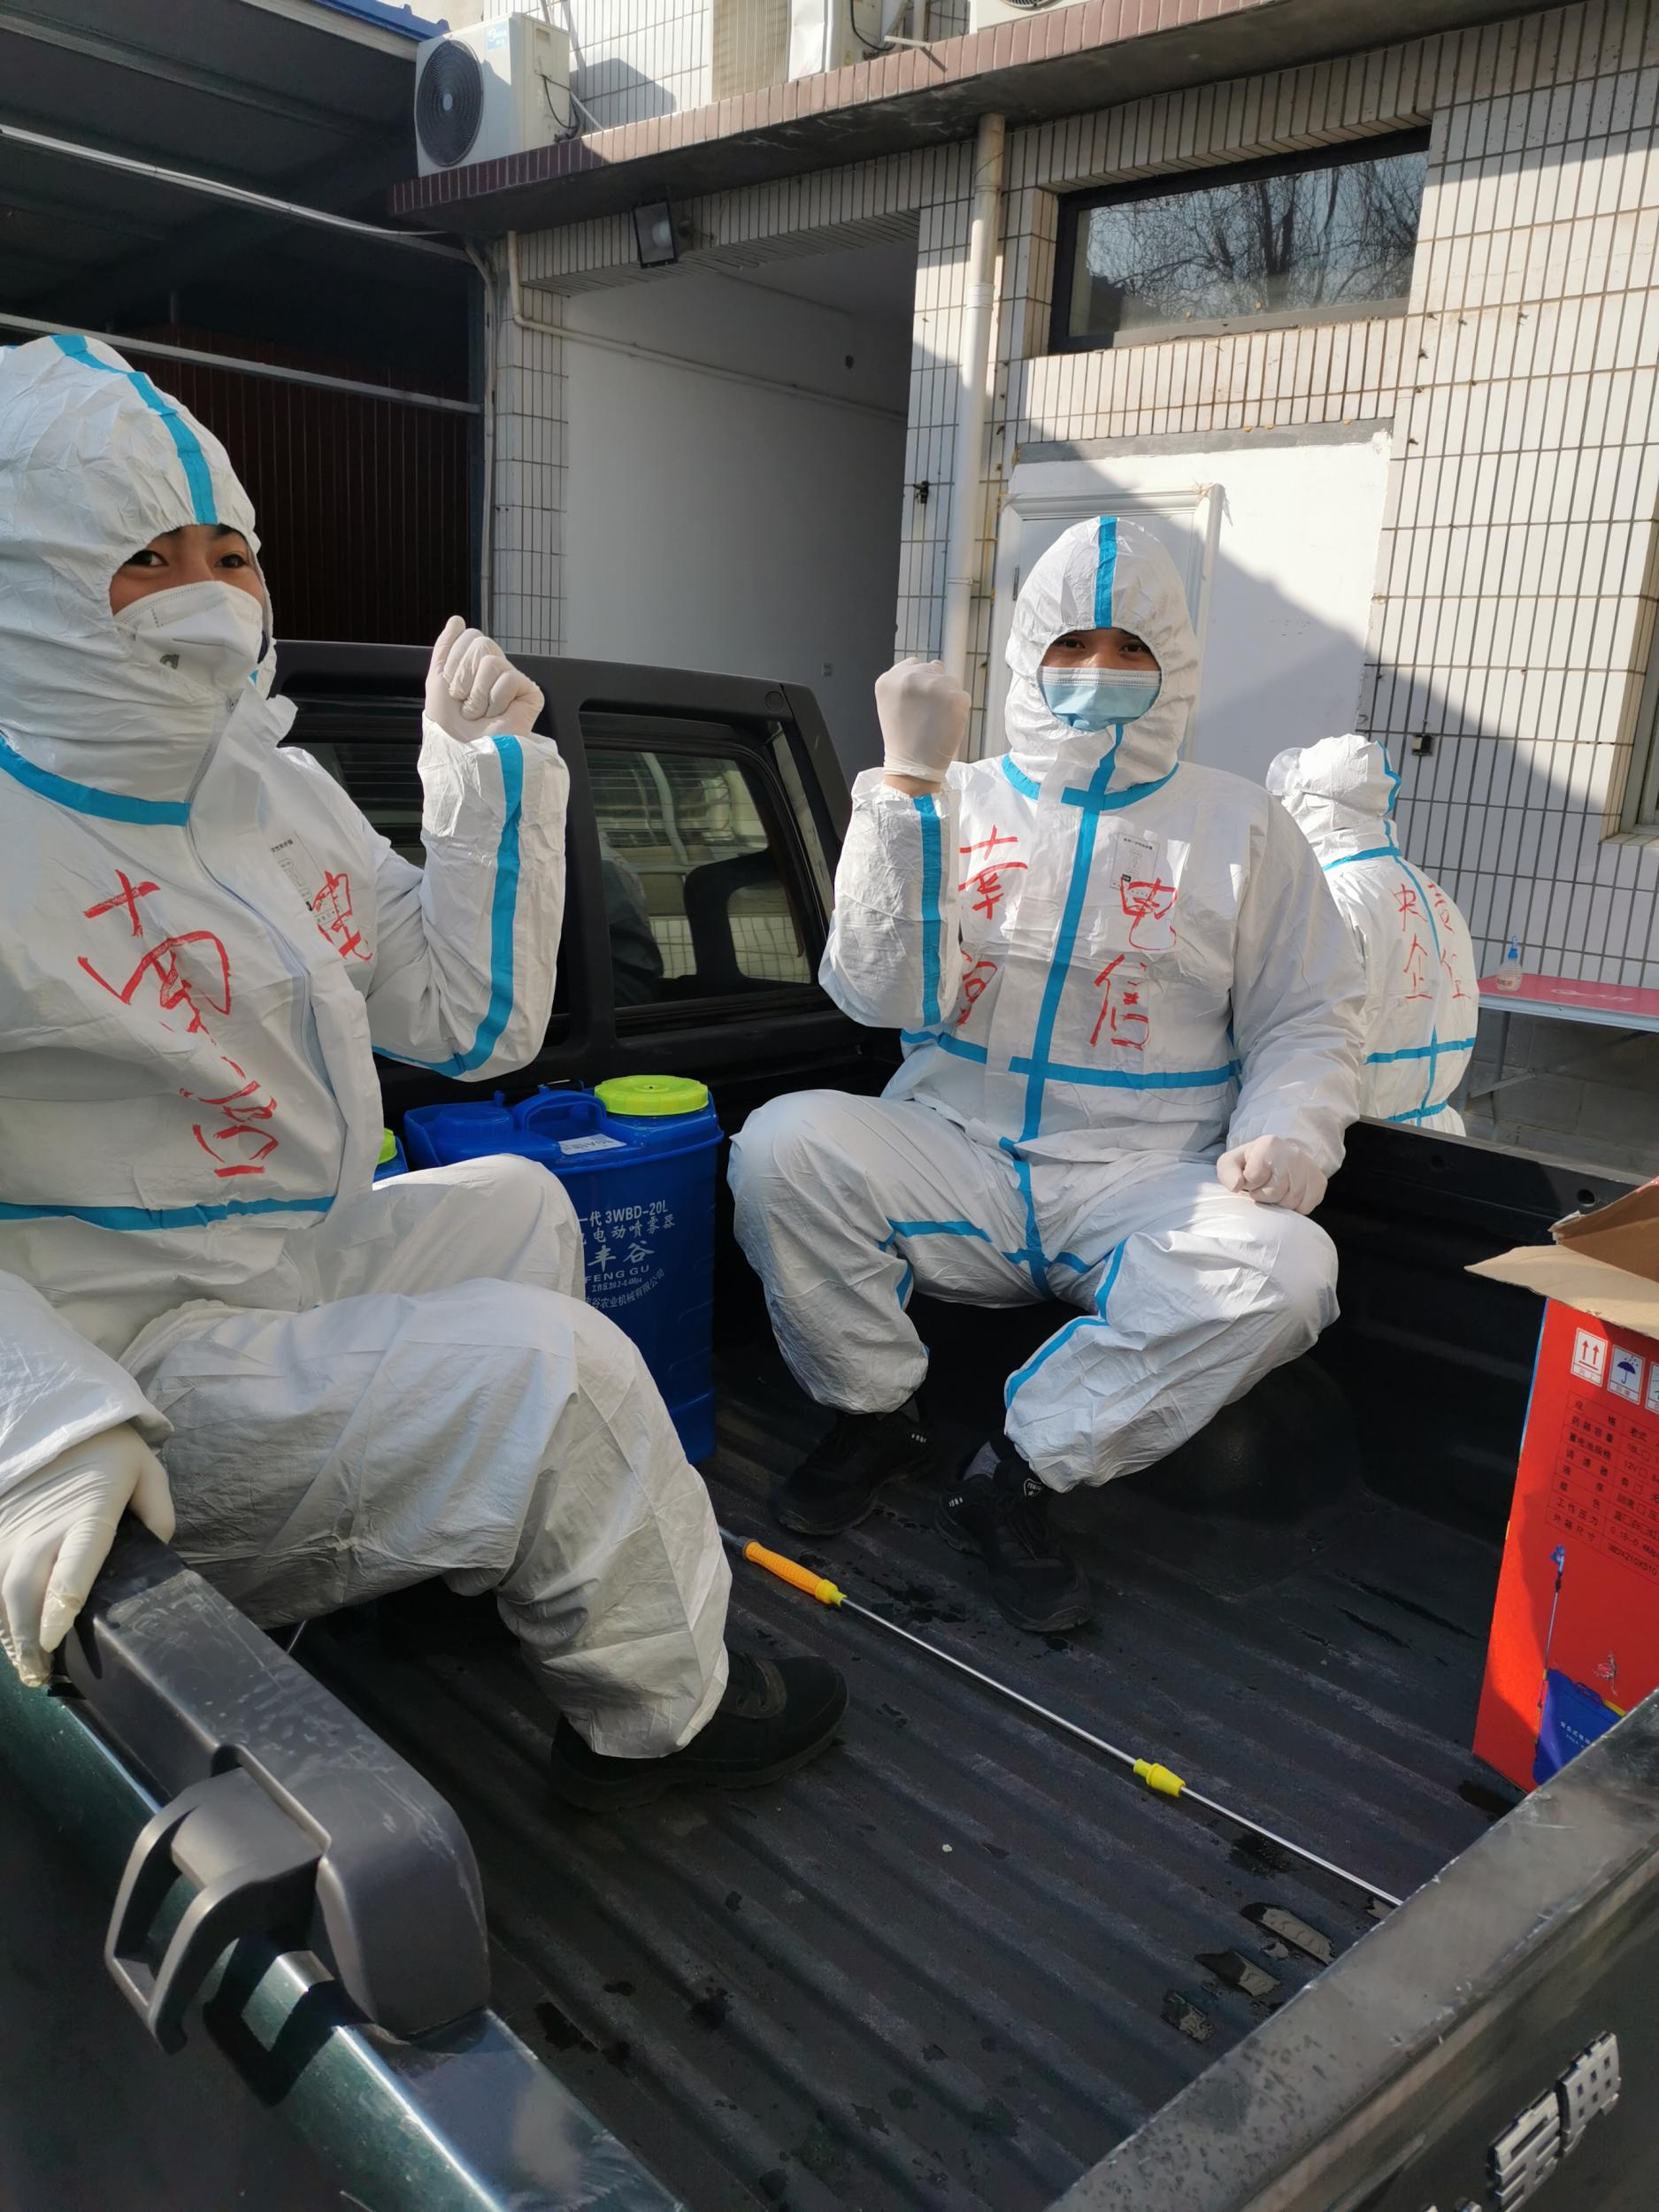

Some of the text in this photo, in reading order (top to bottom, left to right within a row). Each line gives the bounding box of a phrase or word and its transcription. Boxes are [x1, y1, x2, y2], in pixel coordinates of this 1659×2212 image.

[605, 1200, 669, 1224] 3WBD-20L
[581, 1213, 675, 1245] 电动喷雾器
[588, 1240, 655, 1272] 丰谷
[585, 1264, 649, 1285] FENG GU
[1556, 1497, 1599, 1527] 工作压力
